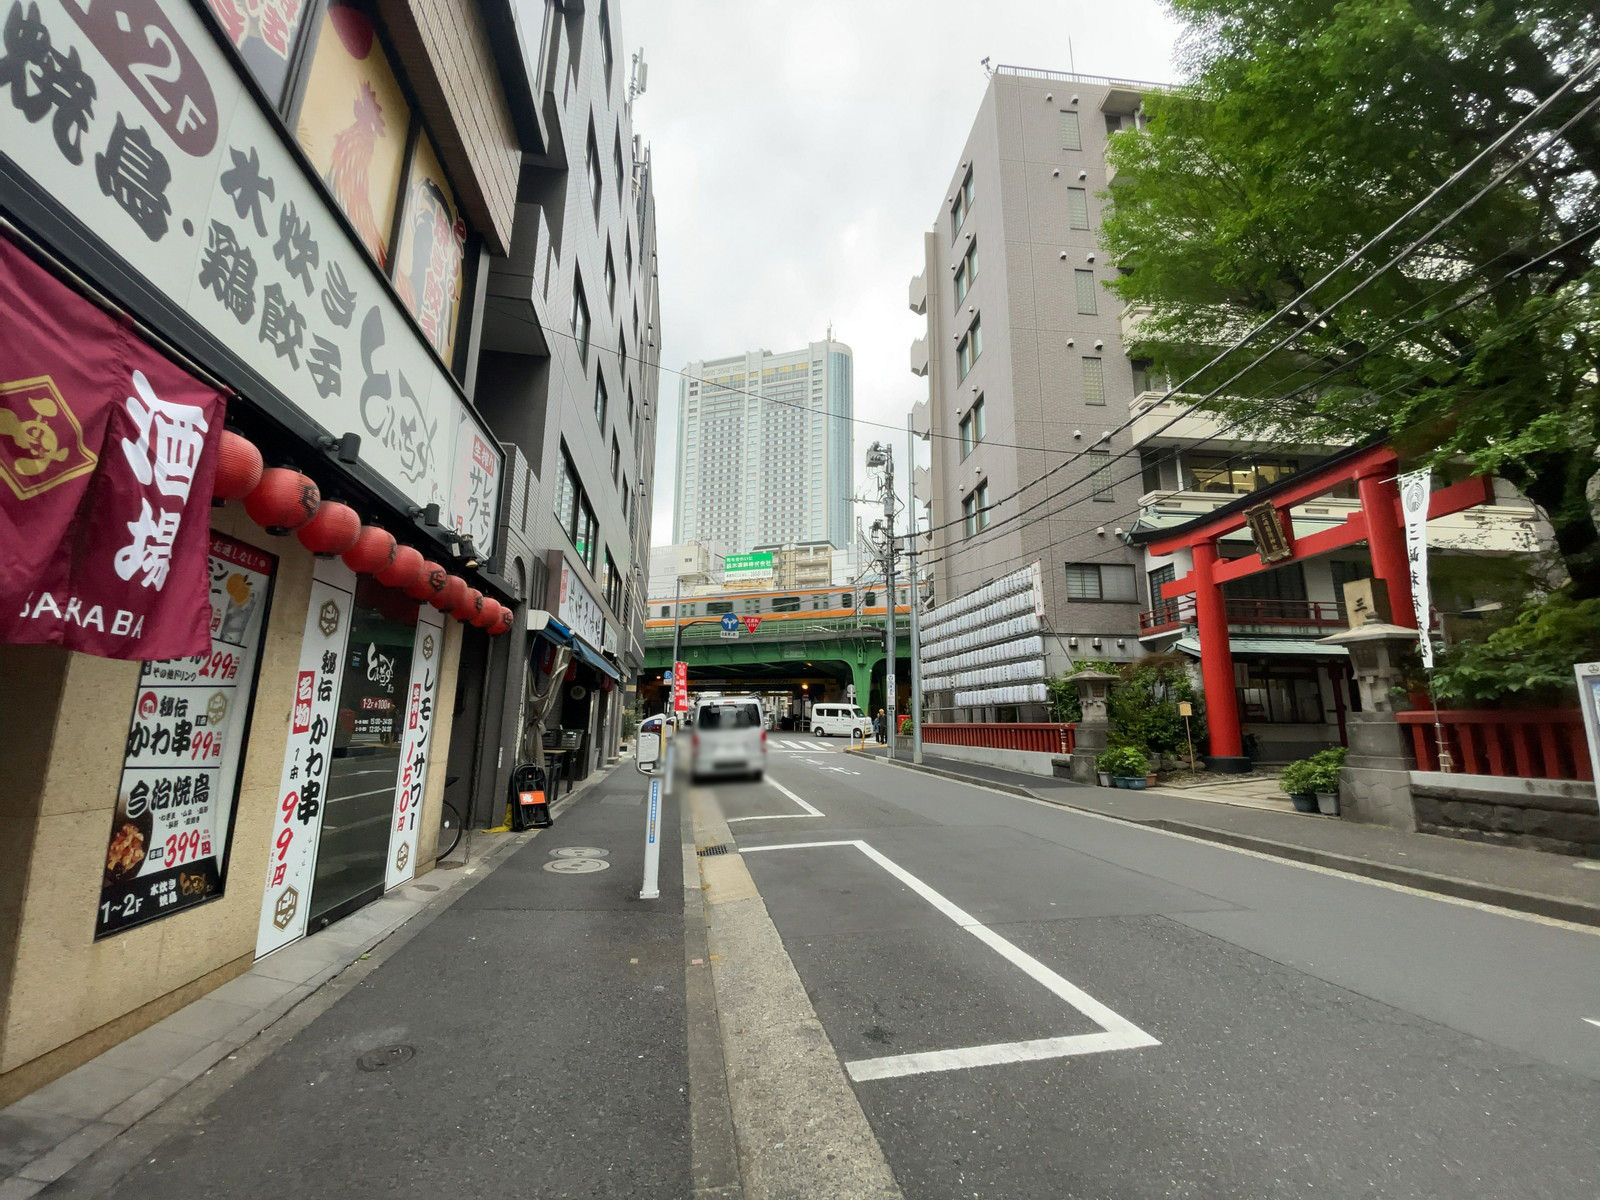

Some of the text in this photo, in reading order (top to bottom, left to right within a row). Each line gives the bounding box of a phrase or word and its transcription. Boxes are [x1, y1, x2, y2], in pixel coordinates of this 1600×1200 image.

[221, 146, 357, 330] 水炊き
[114, 369, 208, 592] 酒場
[467, 464, 483, 535] サワー
[479, 472, 493, 549] レモン
[126, 719, 192, 757] かわ串
[159, 696, 188, 717] 秘伝
[295, 676, 312, 727] 名物
[297, 650, 337, 826] 秘伝 かわ串
[191, 731, 221, 760] 99円
[409, 667, 434, 831] レモンサワー
[127, 773, 210, 817] 今治焼鳥
[397, 741, 415, 832] 150円
[164, 829, 211, 868] 399円
[271, 791, 299, 889] 99円
